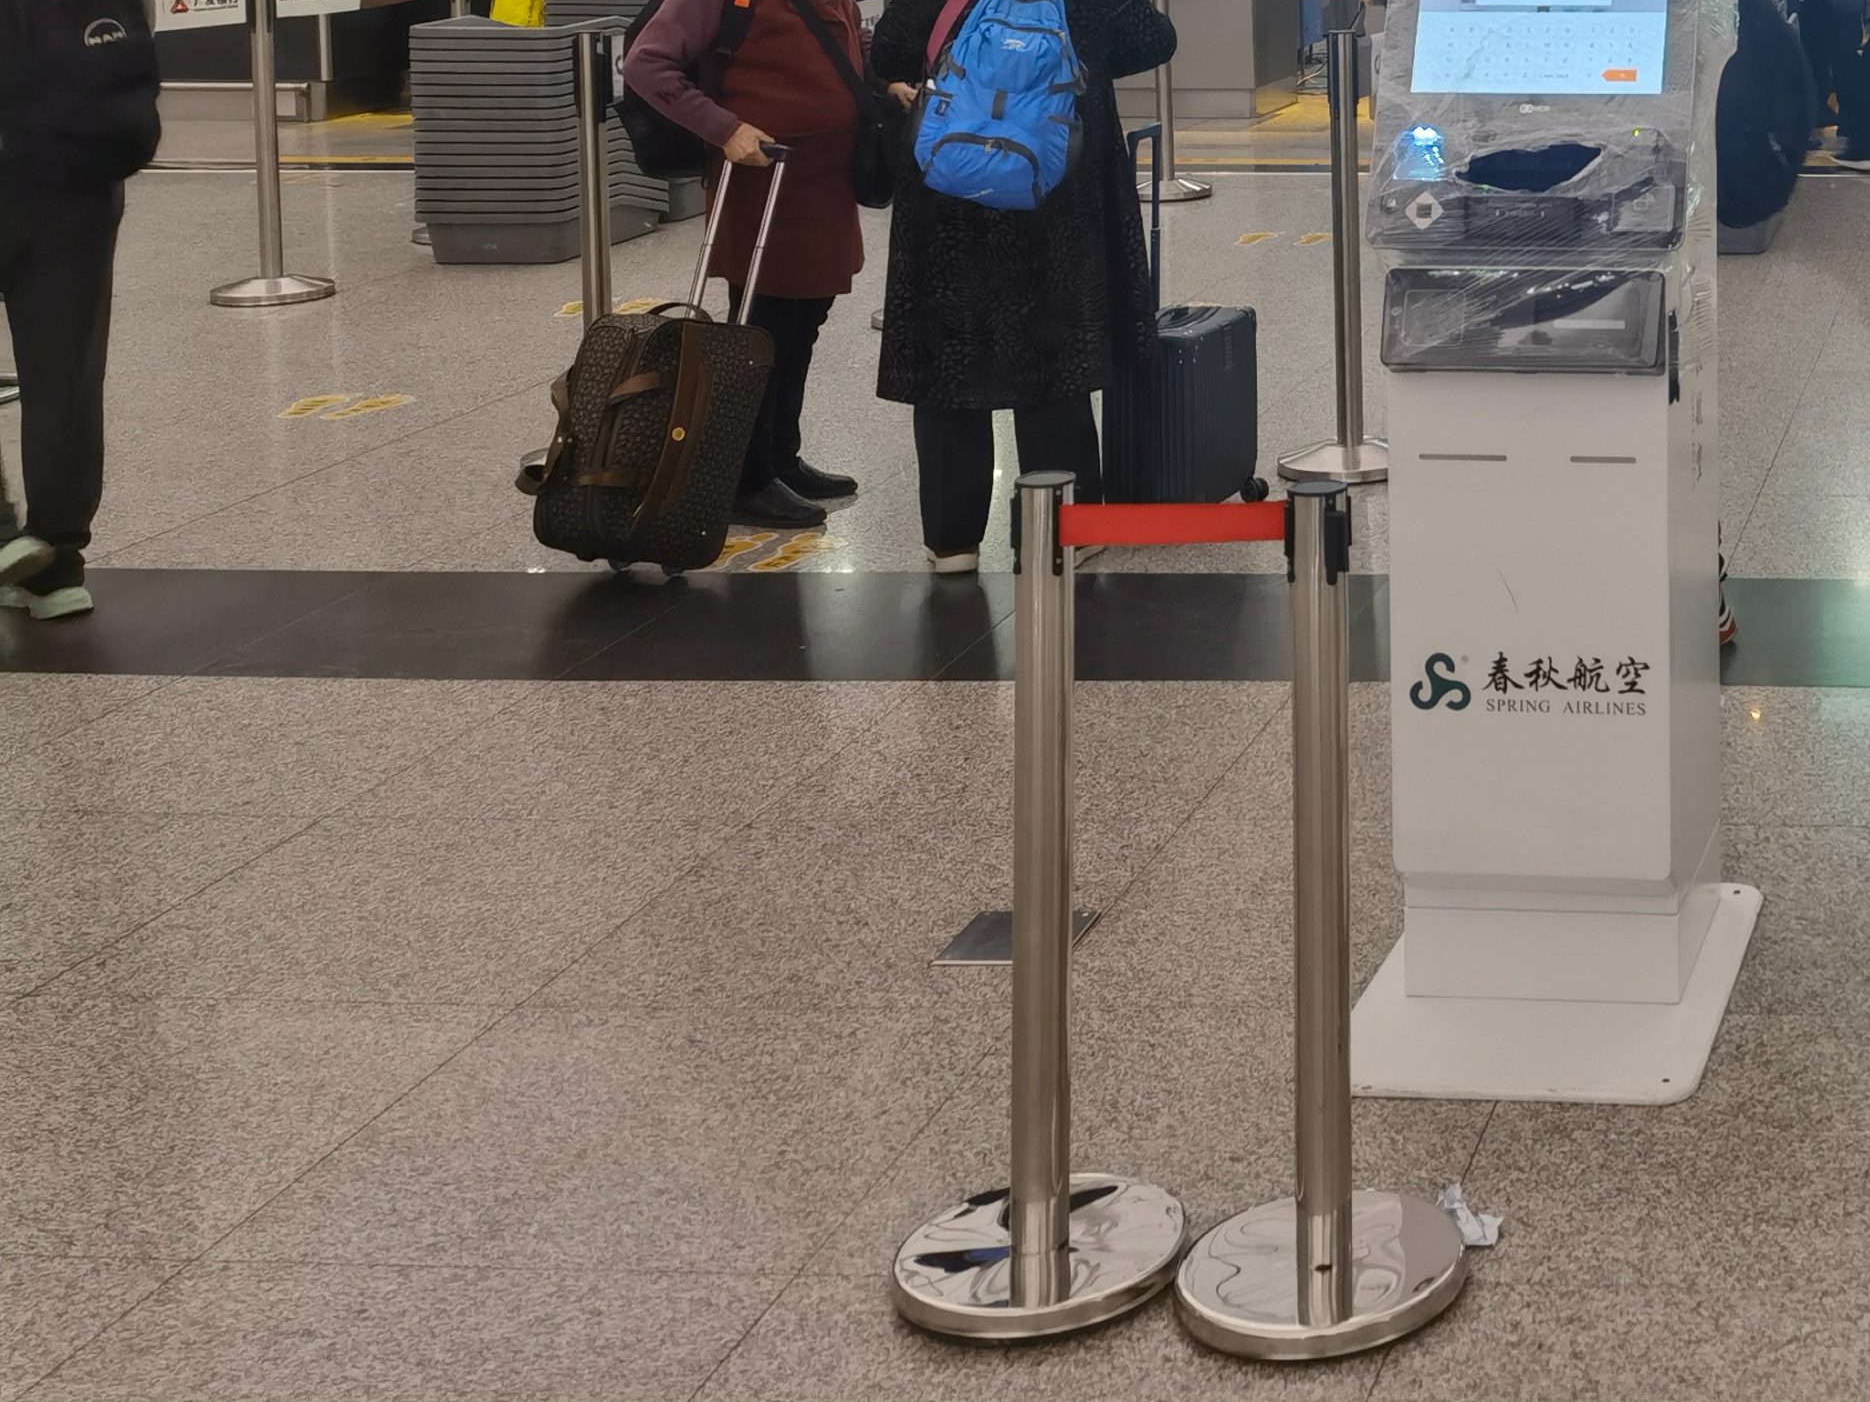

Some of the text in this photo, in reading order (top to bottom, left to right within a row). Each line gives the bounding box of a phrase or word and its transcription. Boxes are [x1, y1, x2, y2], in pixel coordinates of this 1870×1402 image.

[1482, 651, 1650, 695] 春秋航空
[1486, 698, 1647, 716] SPRING AIRLINES
